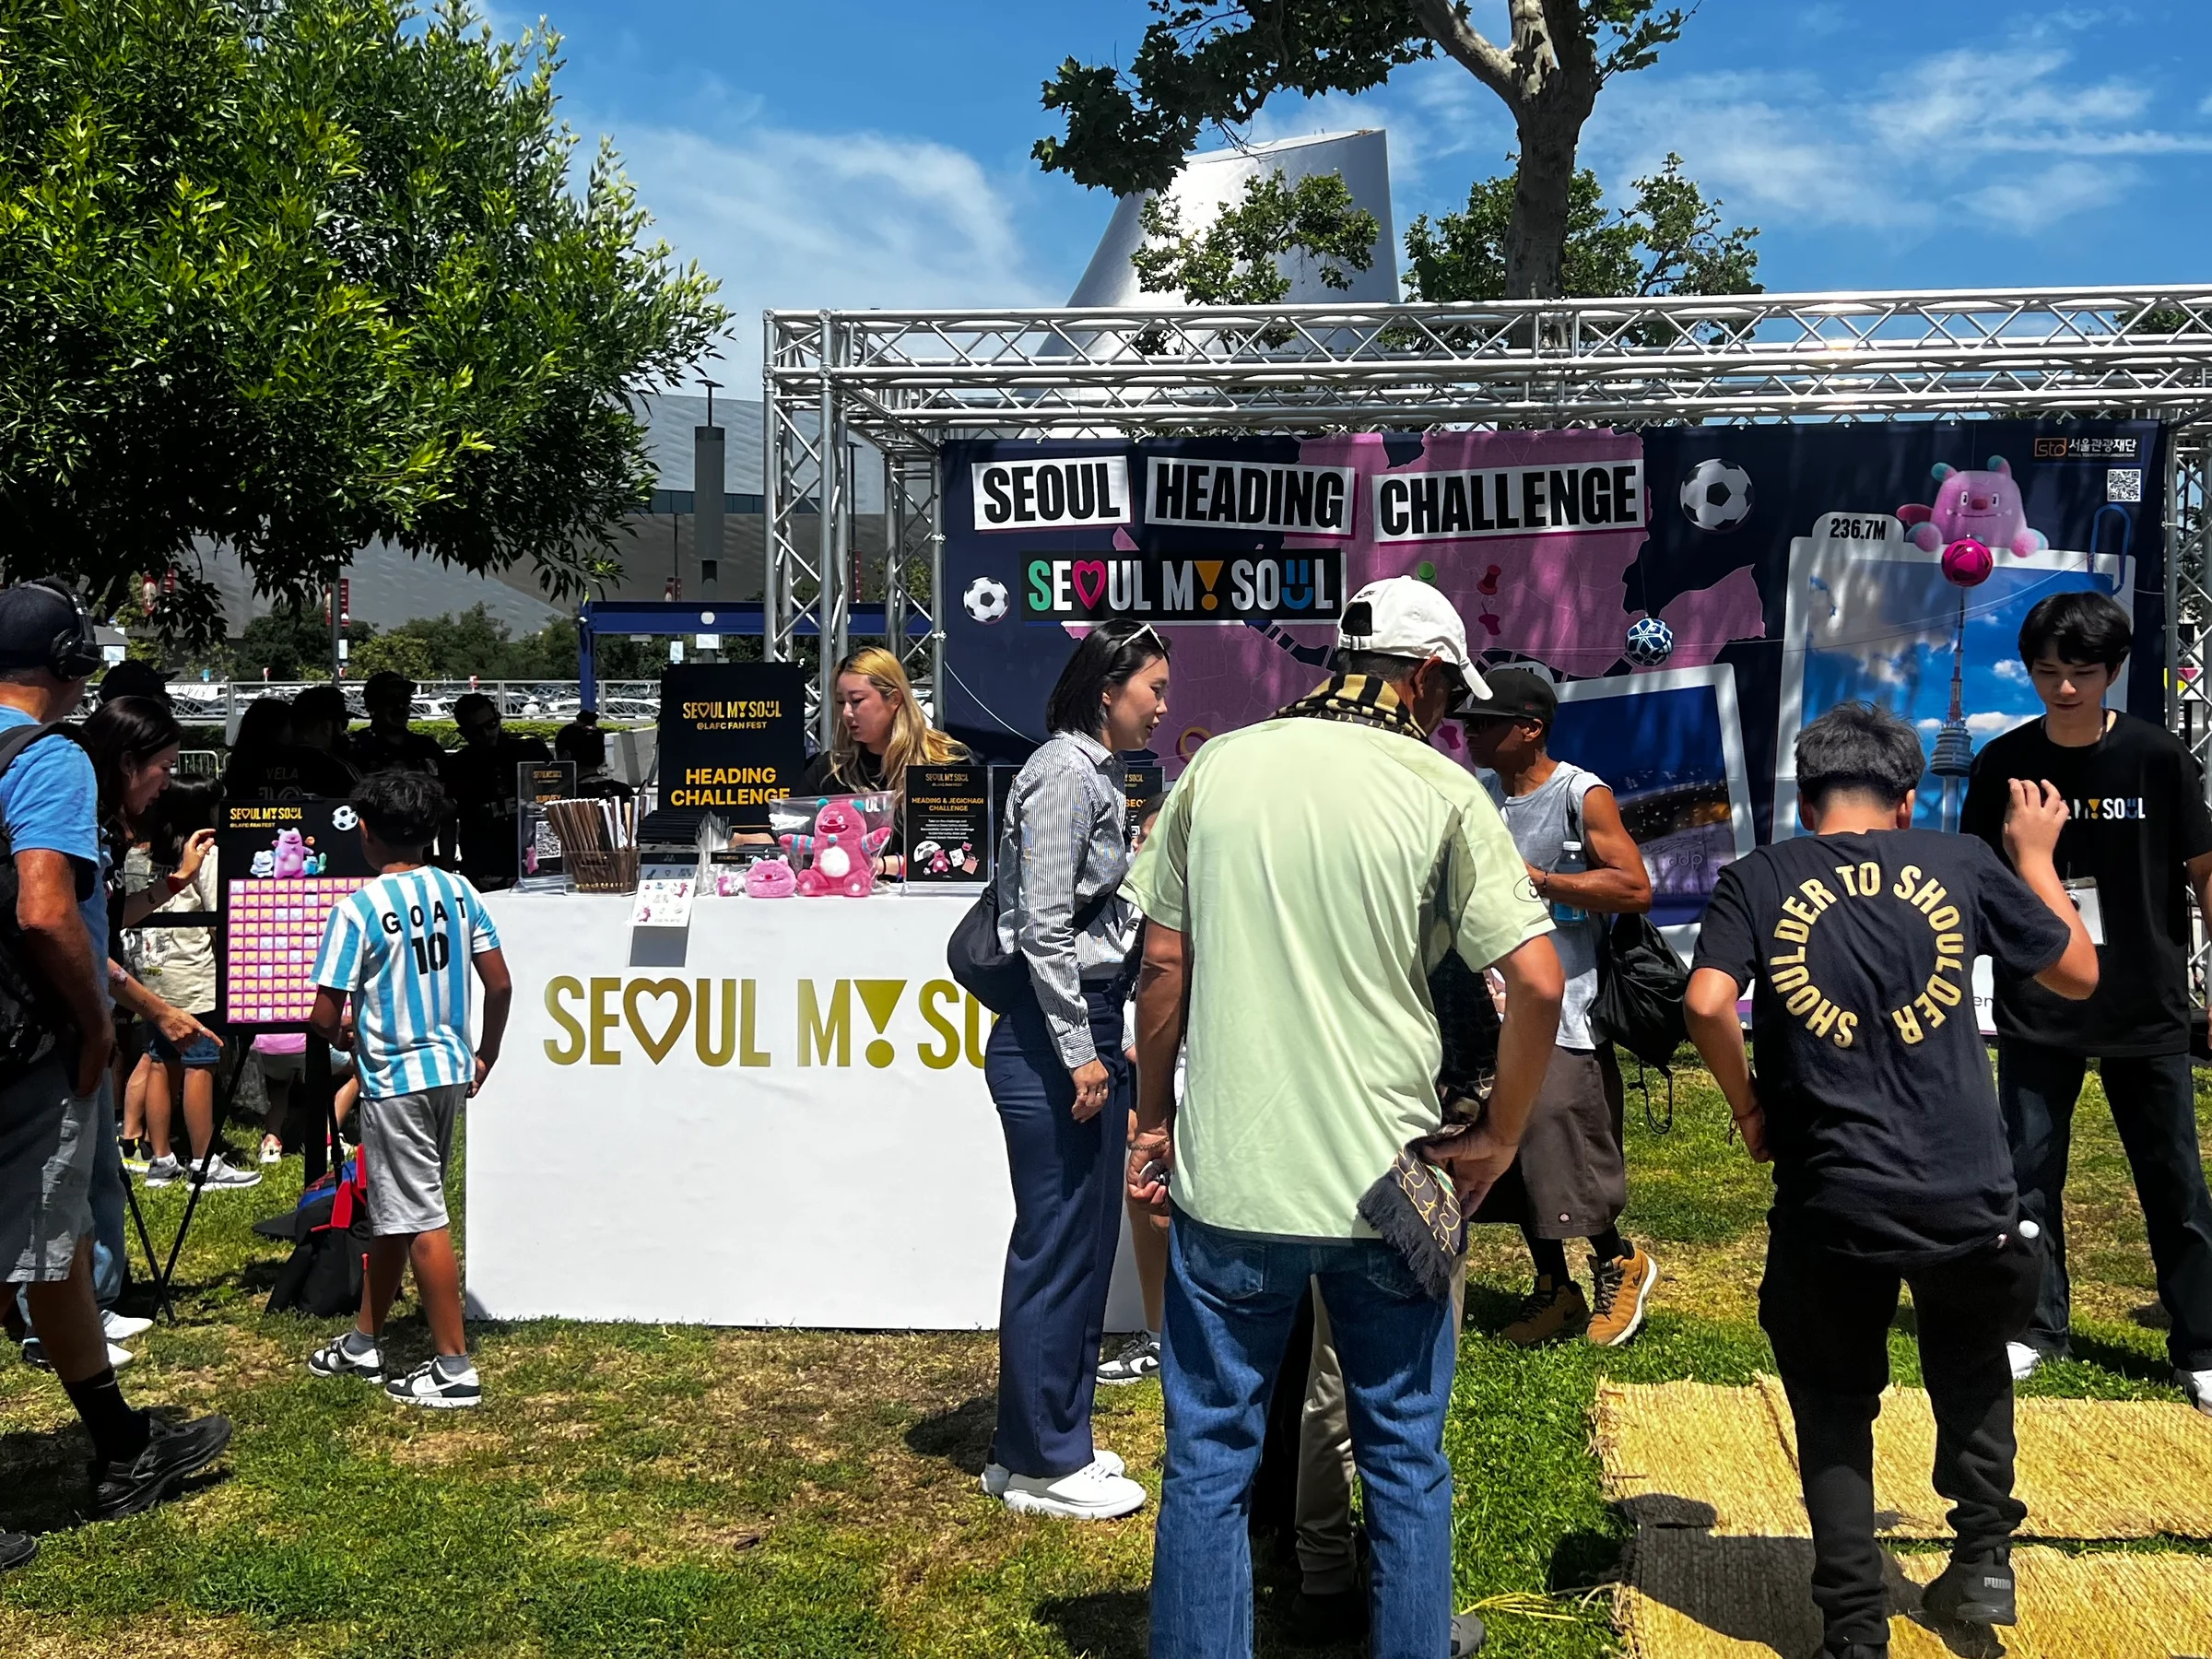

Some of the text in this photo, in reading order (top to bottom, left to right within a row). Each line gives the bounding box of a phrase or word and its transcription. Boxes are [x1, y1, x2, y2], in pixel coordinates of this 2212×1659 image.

[2068, 438, 2136, 453] 서울관광재단
[982, 463, 1638, 536] SEOUL HEADING CHALLENGE
[1830, 518, 1887, 540] 236.7M
[1230, 559, 1334, 610] SOUL
[748, 700, 782, 718] SOUL
[746, 721, 768, 729] FEST
[265, 766, 300, 781] VELA
[686, 767, 777, 784] HEADING
[671, 788, 790, 806] CHALLENGE
[277, 807, 303, 820] SOUL
[2102, 797, 2146, 819] SOUL
[1669, 850, 1703, 871] ddp
[382, 897, 466, 935] GOAT
[410, 932, 450, 975] 10
[1770, 862, 1964, 1049] SHOULDER TO SHOULDER
[917, 979, 1001, 1070] SO
